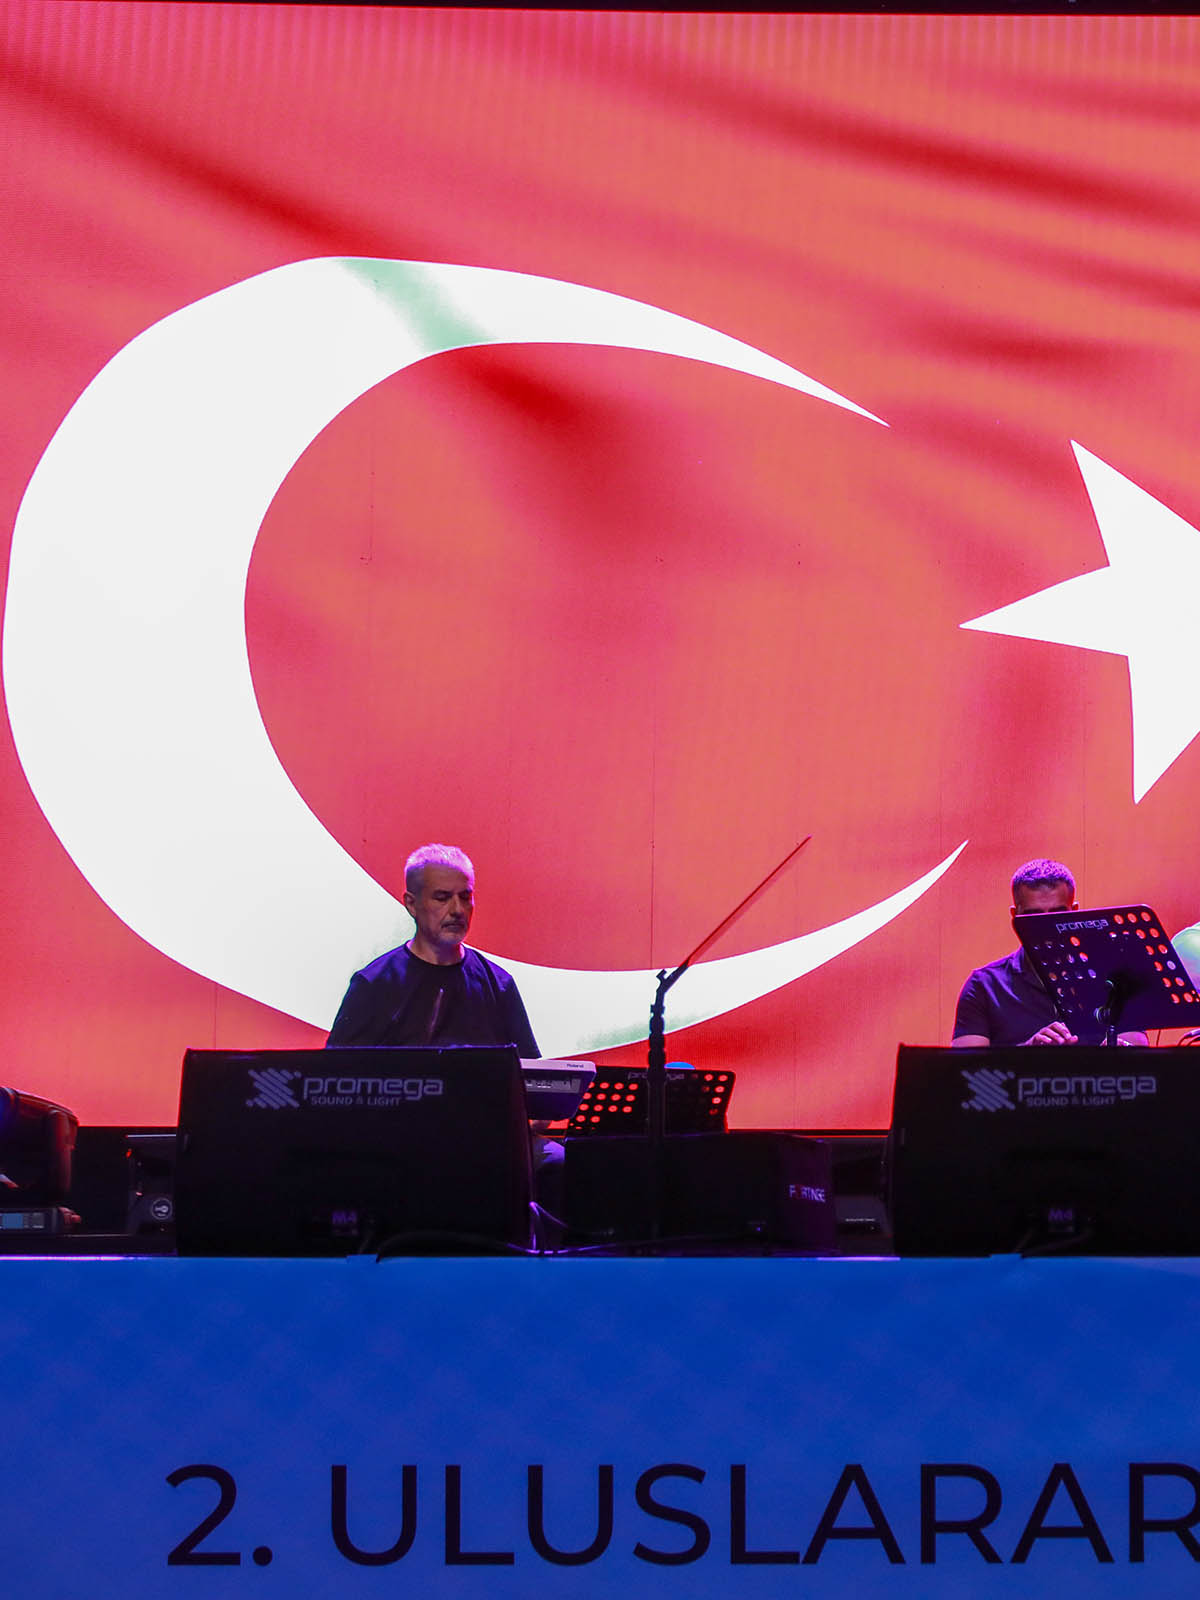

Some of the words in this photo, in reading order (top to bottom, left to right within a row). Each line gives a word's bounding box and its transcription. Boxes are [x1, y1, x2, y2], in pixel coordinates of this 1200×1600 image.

[1056, 919, 1109, 934] promega
[303, 1077, 444, 1101] promega
[1018, 1076, 1157, 1102] promega
[311, 1095, 353, 1106] SOUND
[367, 1096, 401, 1106] LIGHT
[1026, 1096, 1070, 1107] SOUND
[1082, 1096, 1116, 1106] LIGHT
[166, 1464, 273, 1566] 2.
